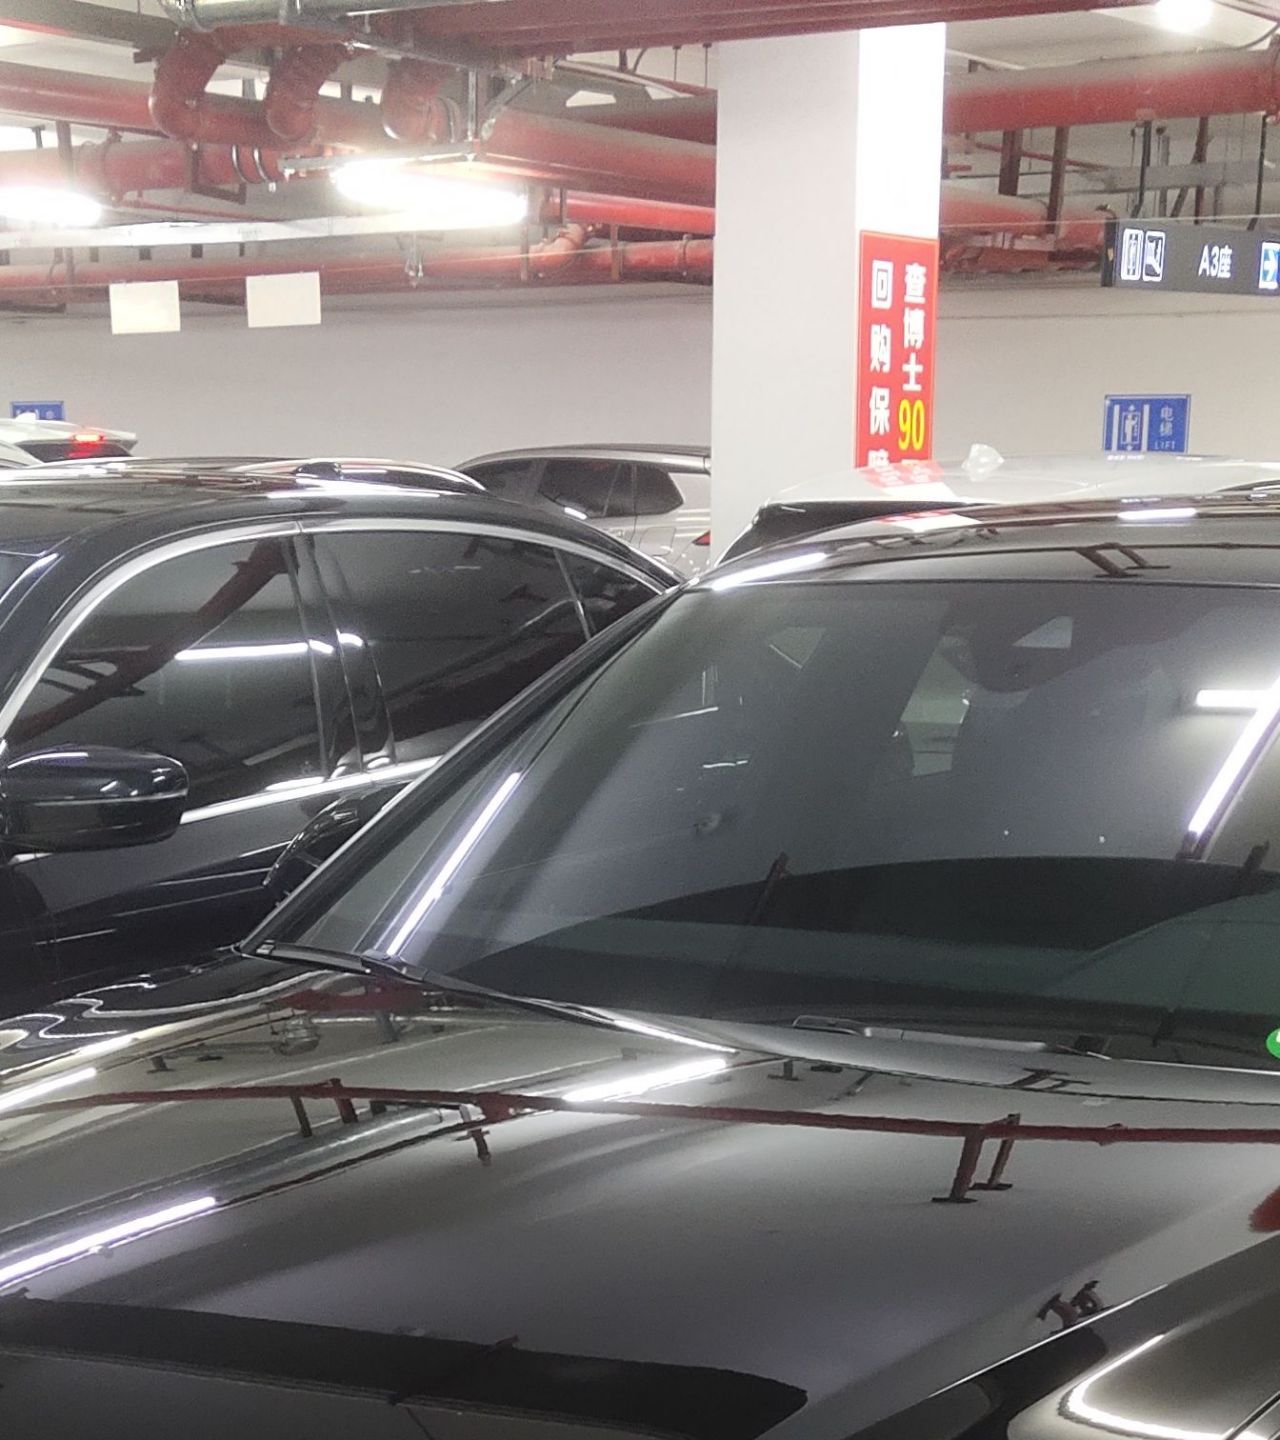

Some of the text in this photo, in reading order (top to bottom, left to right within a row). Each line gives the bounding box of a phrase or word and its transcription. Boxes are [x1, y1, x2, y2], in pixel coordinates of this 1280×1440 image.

[1198, 244, 1233, 279] A3座
[898, 262, 926, 466] 查博士90
